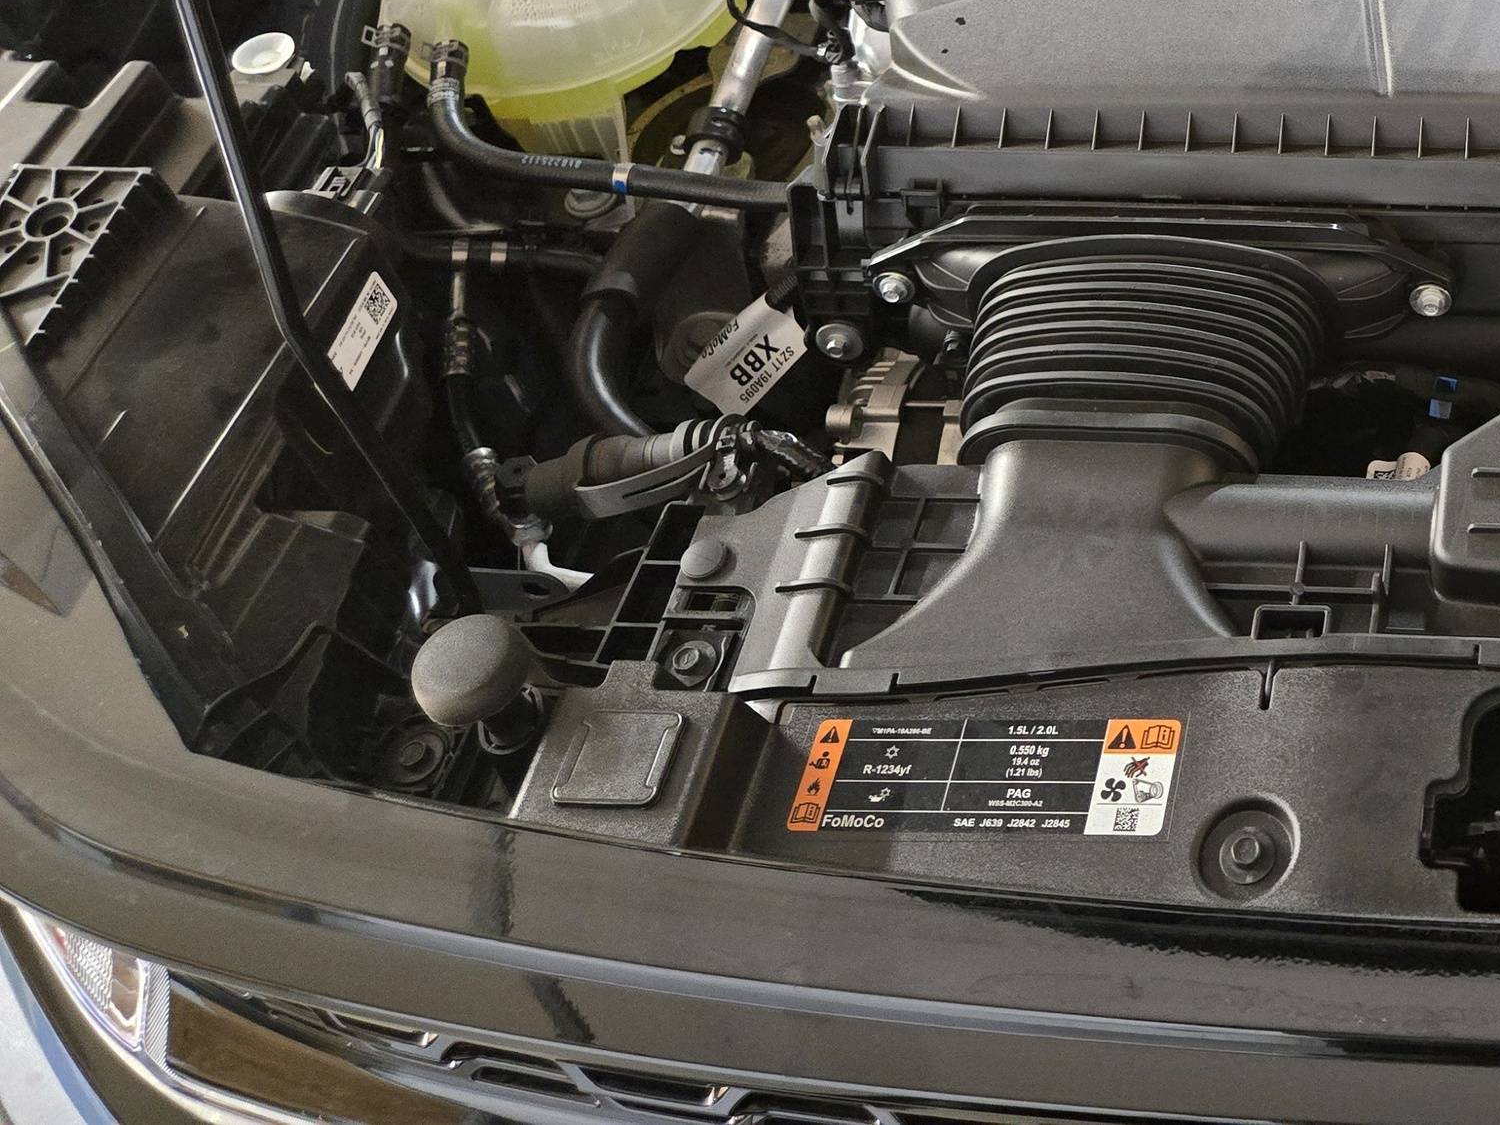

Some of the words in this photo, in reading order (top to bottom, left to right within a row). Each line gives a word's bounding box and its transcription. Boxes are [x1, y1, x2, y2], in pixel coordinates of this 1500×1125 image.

[702, 319, 739, 359] FoMoCo
[730, 334, 780, 386] XBB
[772, 346, 794, 372] SZ1T
[739, 370, 772, 403] 19A095
[1008, 726, 1029, 735] 1.5L
[1037, 726, 1059, 735] 2.0L
[1009, 746, 1035, 756] 0.550
[1037, 746, 1050, 758] kg
[1012, 758, 1028, 766] 19.4
[863, 764, 912, 776] R-1234yf
[1005, 768, 1024, 778] (1.21
[1026, 767, 1042, 778] lbs)
[1006, 788, 1032, 799] PAG
[822, 815, 885, 828] FoMoCo
[953, 818, 975, 827] SAE
[979, 818, 1003, 828] J639
[1007, 818, 1036, 827] J2842
[1041, 818, 1071, 828] J2845
